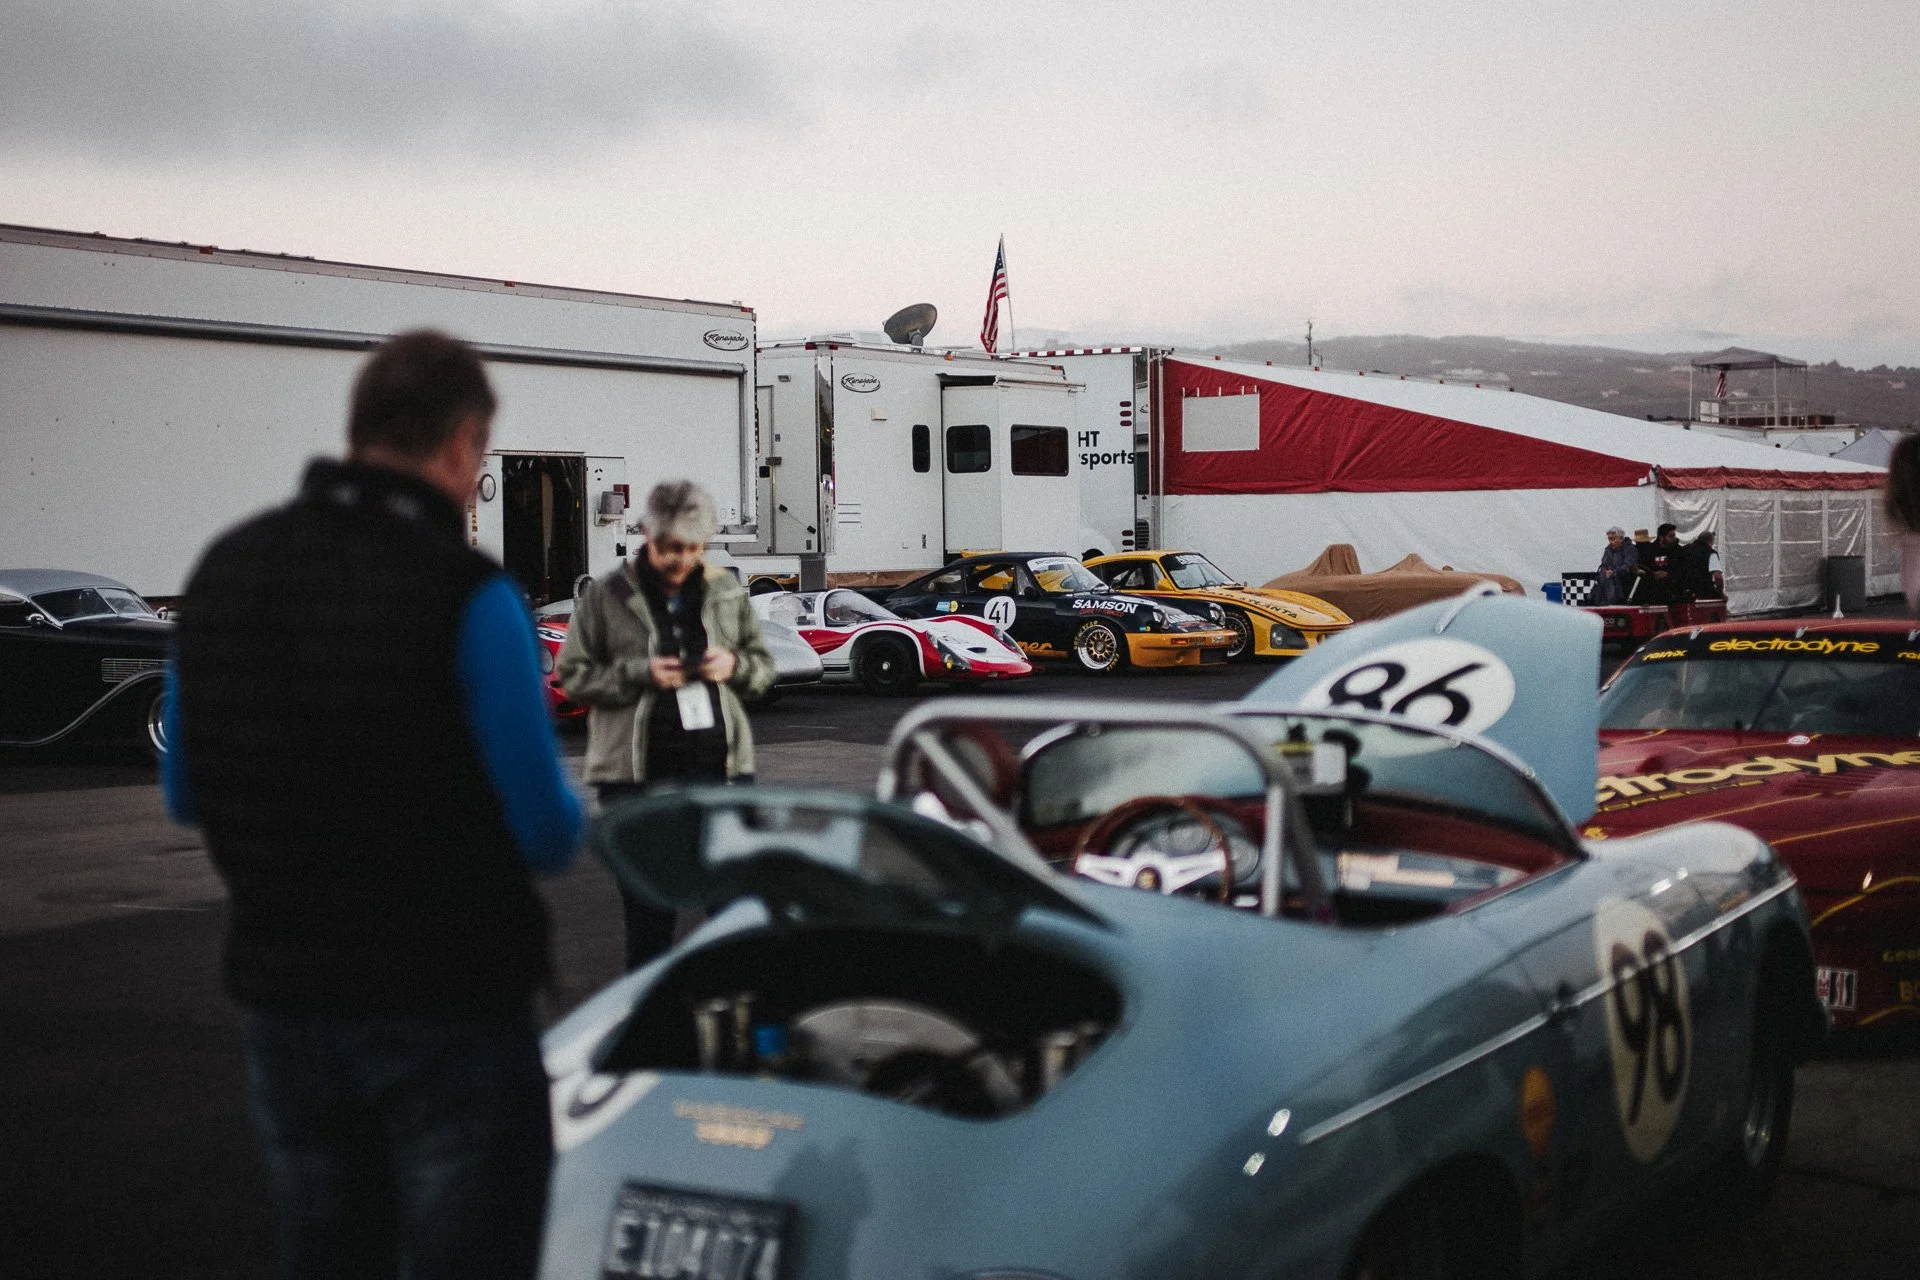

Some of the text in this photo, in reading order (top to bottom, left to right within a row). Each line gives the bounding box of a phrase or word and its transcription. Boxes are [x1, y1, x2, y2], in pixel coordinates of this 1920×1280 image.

[704, 332, 746, 346] Renegade
[1079, 449, 1135, 470] sports
[988, 601, 1009, 624] 41
[1072, 598, 1139, 614] SAMSON
[1708, 637, 1880, 654] electrodyne
[1611, 928, 1685, 1126] 98
